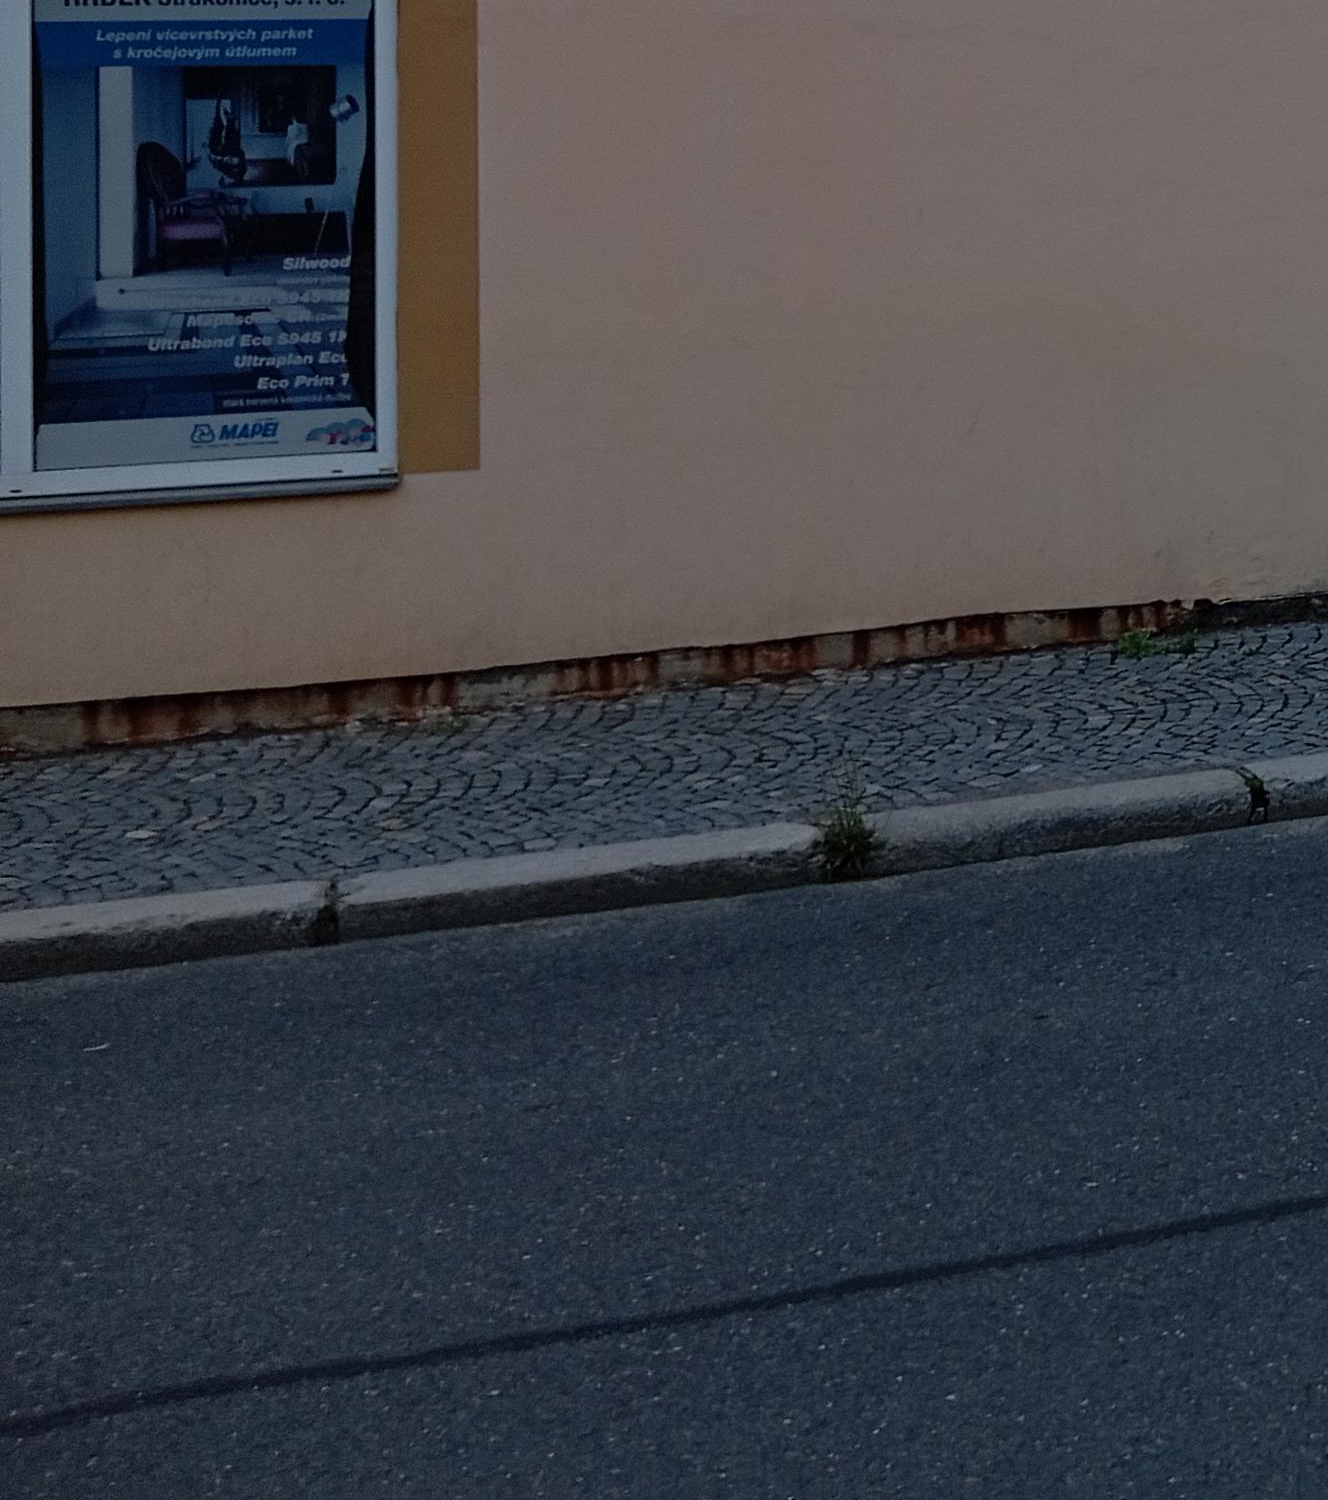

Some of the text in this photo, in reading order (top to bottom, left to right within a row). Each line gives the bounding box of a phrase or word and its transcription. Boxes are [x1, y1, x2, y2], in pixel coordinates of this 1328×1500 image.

[96, 26, 314, 44] Lepení vícevrstvých parket
[113, 43, 297, 61] s kročejovým útlumem
[283, 255, 351, 270] Silwood
[147, 334, 234, 353] Ultrabond
[240, 333, 272, 348] Eco
[277, 331, 322, 346] S945
[234, 352, 314, 370] Ultraplan
[257, 376, 289, 390] Eco
[294, 373, 335, 388] Prim
[219, 421, 280, 441] MAPEI
